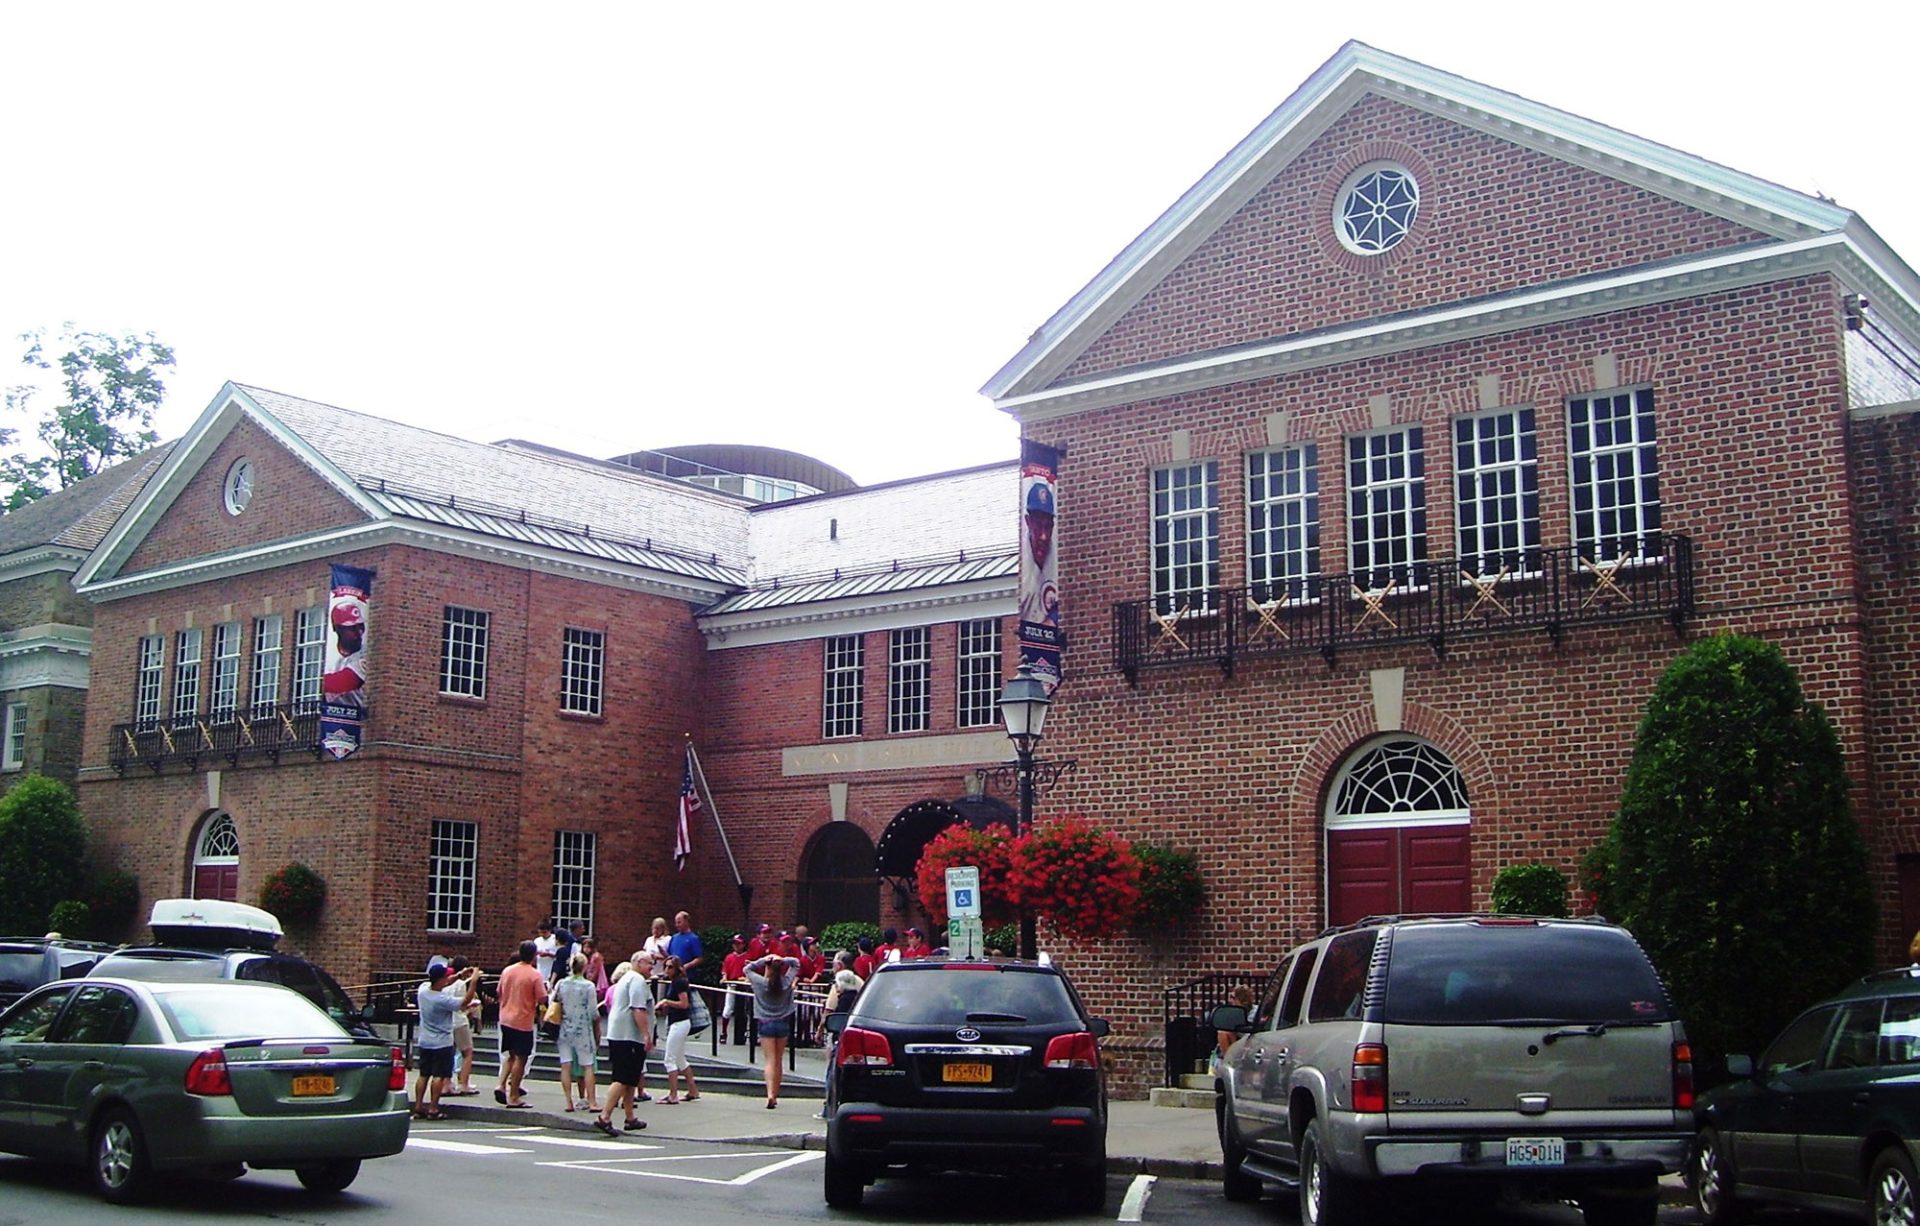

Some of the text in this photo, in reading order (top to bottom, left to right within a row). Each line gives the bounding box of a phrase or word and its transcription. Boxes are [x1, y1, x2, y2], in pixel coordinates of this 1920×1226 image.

[1024, 626, 1043, 637] JULY
[1043, 630, 1055, 640] 22
[326, 705, 358, 716] JULY 22
[948, 872, 977, 880] RESERVED
[950, 879, 975, 888] PARKING
[950, 922, 959, 936] 2
[1408, 1097, 1469, 1105] SUBURBAN
